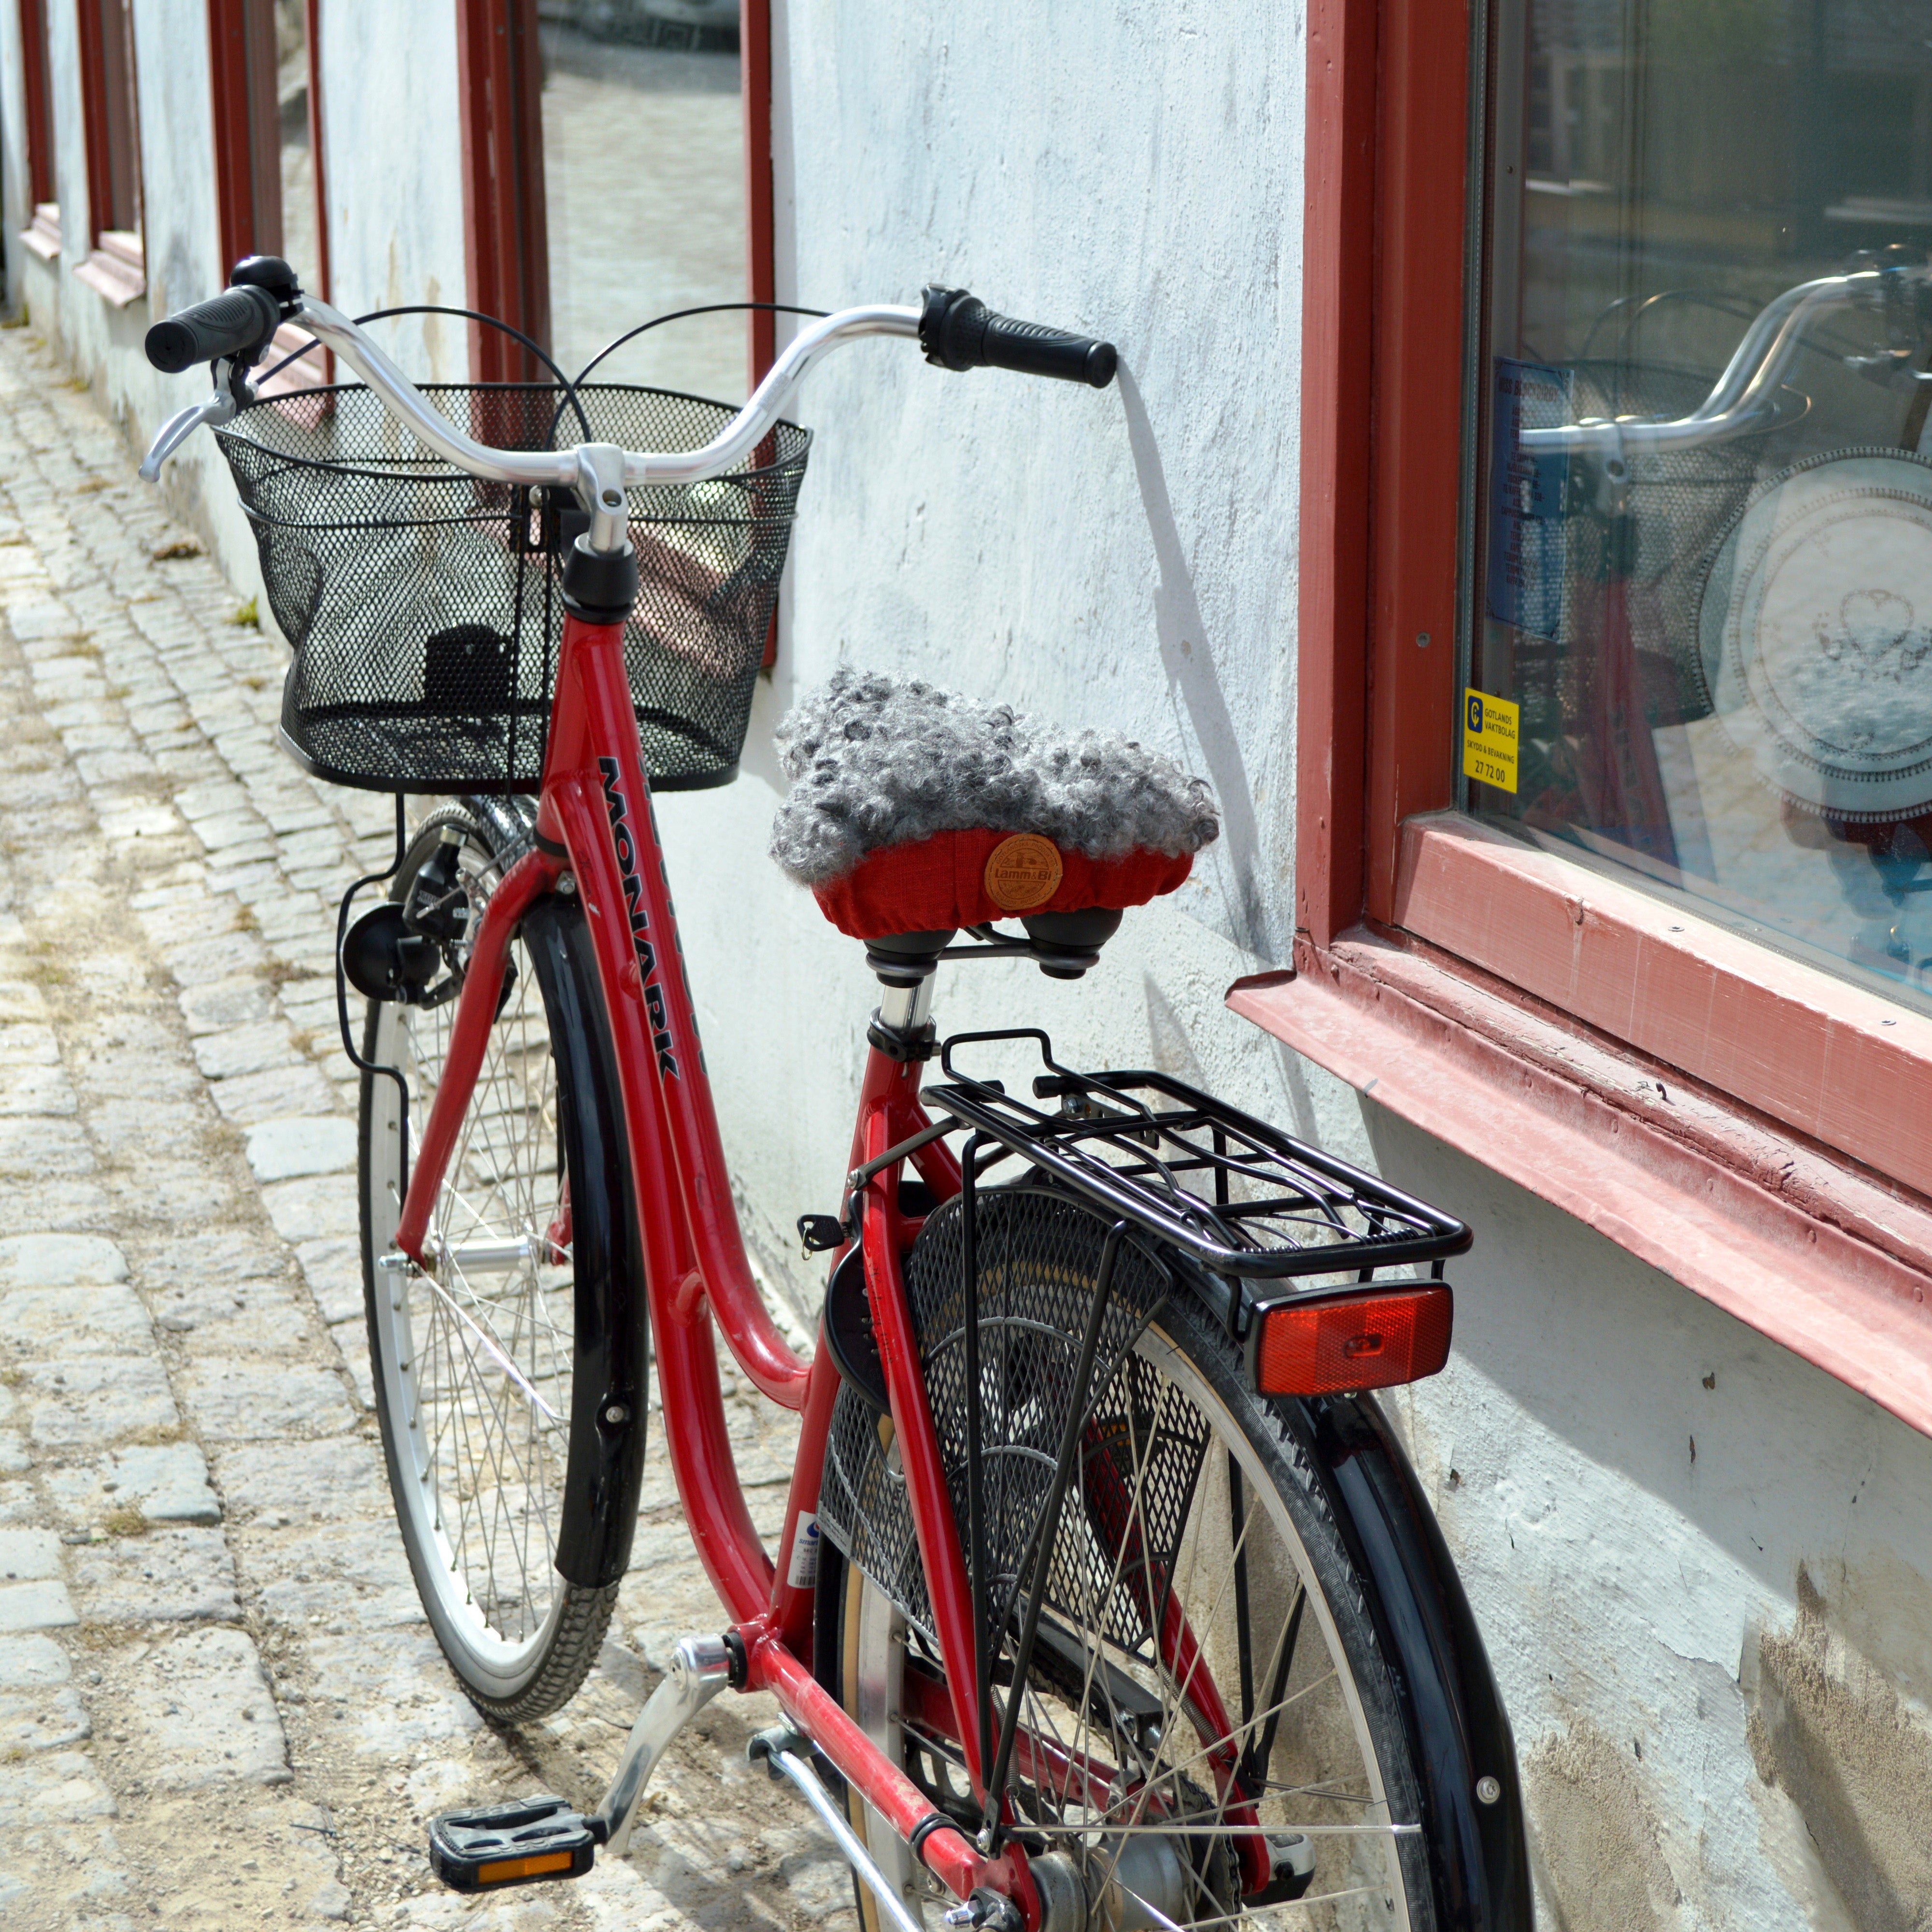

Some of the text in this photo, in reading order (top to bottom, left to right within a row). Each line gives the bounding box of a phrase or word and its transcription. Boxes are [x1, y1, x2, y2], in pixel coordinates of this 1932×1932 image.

[1485, 708, 1512, 724] GOTLANDS
[1485, 720, 1515, 739] VAKTBOLAG
[1467, 739, 1483, 753] SKYDD
[1488, 746, 1515, 764] BEVAKNING
[1475, 760, 1505, 783] 27 72 00
[1031, 842, 1056, 867] PRODUKTER
[598, 756, 681, 1082] MONARK
